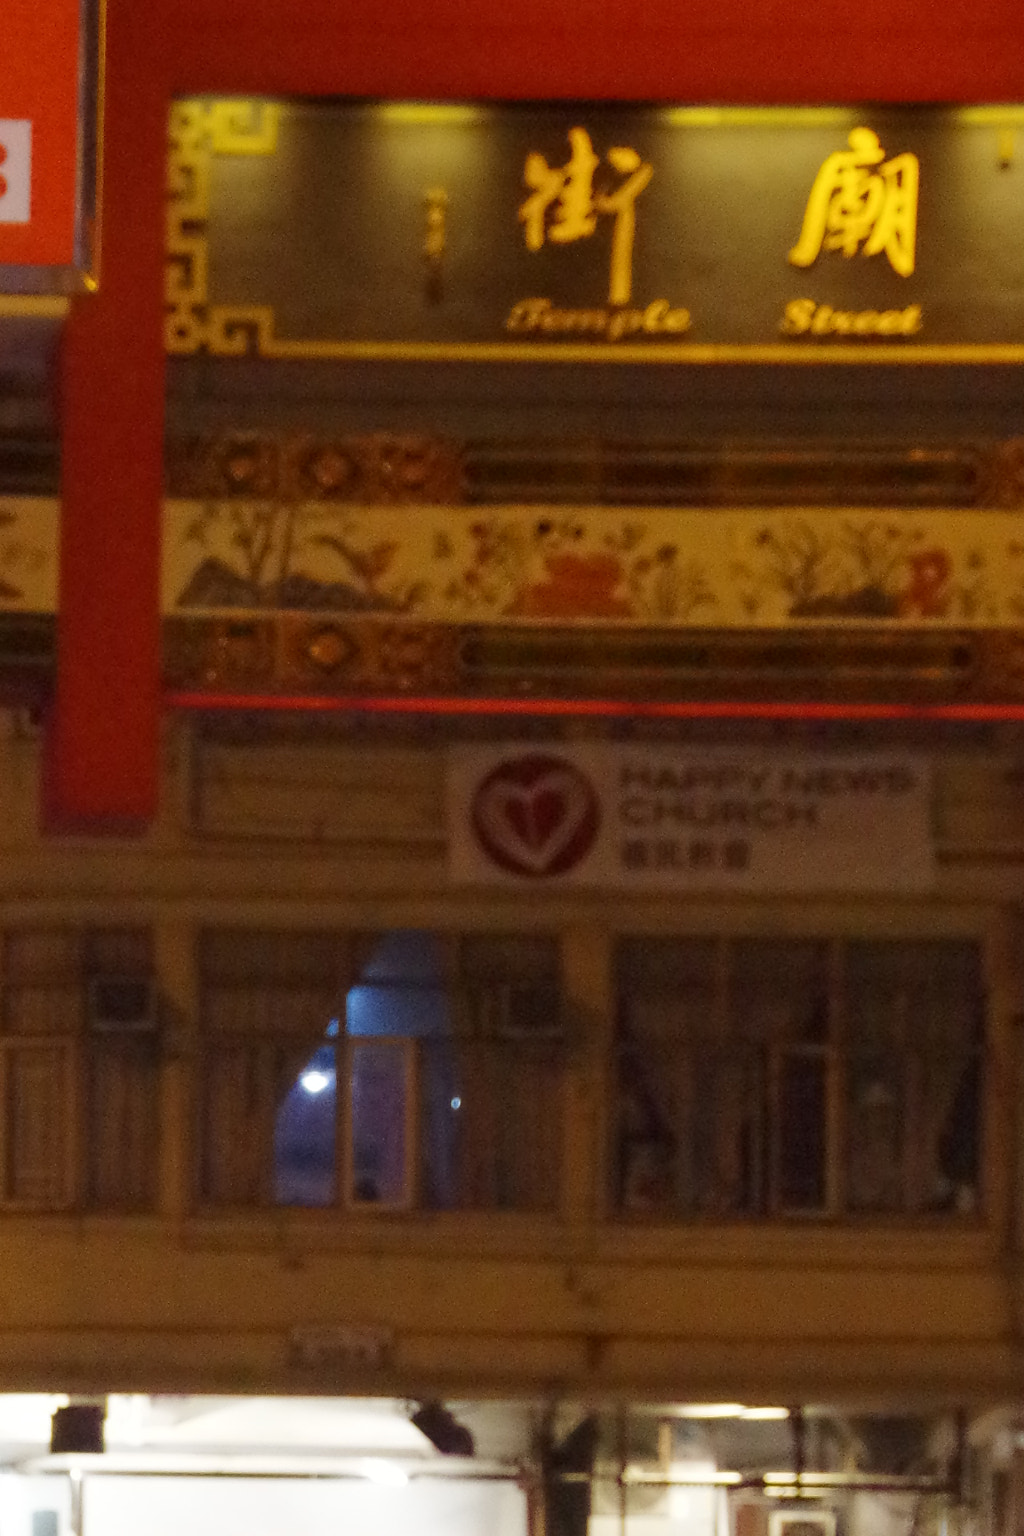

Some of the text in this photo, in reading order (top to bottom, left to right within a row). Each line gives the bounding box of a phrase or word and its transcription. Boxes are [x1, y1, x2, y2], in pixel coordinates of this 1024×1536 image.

[506, 298, 923, 342] Temple Street
[618, 797, 819, 830] CHURCH
